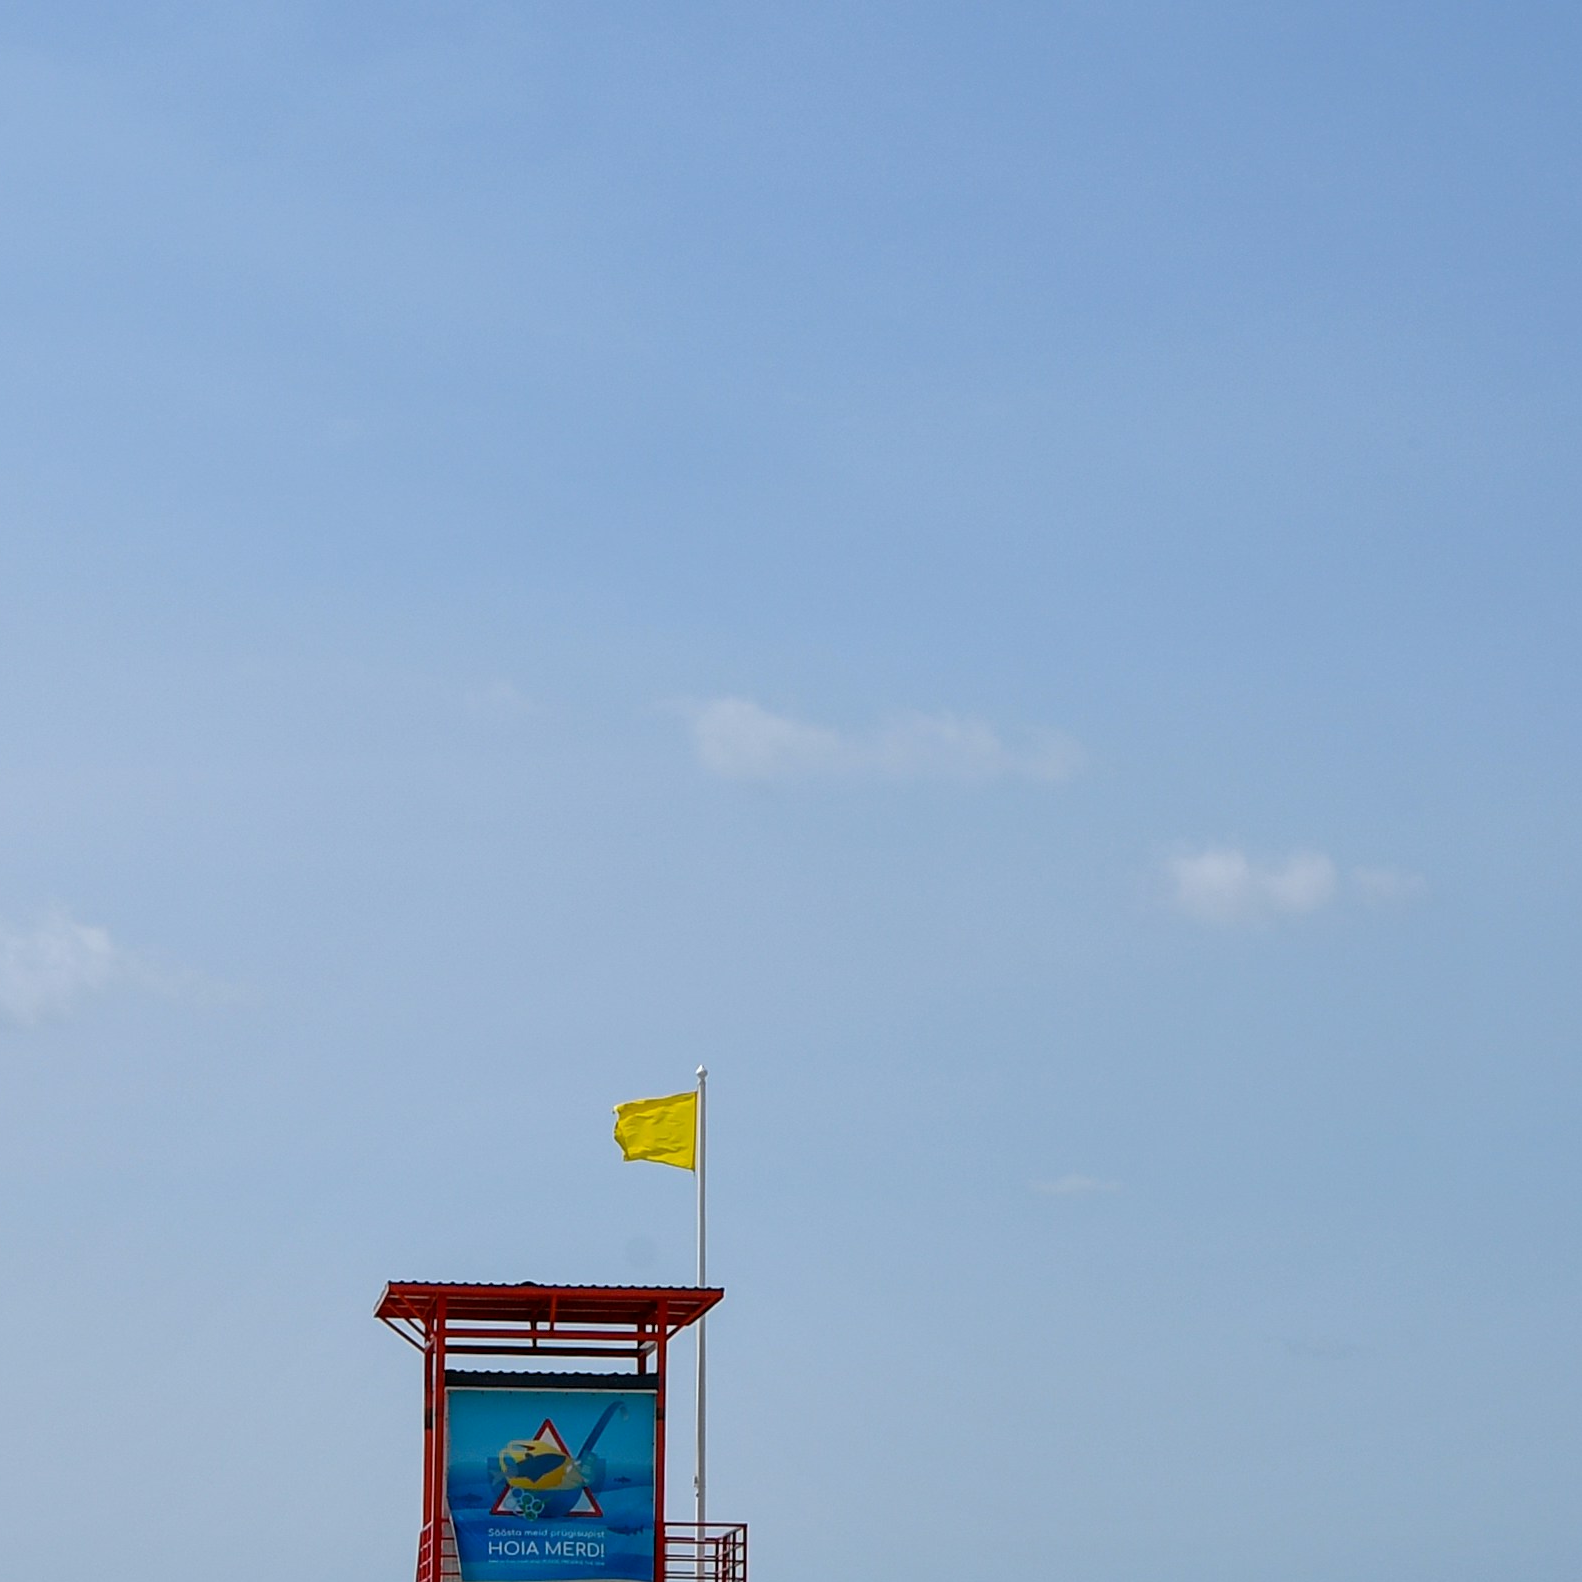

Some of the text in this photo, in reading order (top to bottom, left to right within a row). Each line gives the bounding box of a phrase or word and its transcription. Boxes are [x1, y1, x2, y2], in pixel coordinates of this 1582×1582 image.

[524, 1529, 547, 1537] meid
[550, 1529, 605, 1539] prügisupist
[488, 1540, 605, 1558] HOIA MERD!
